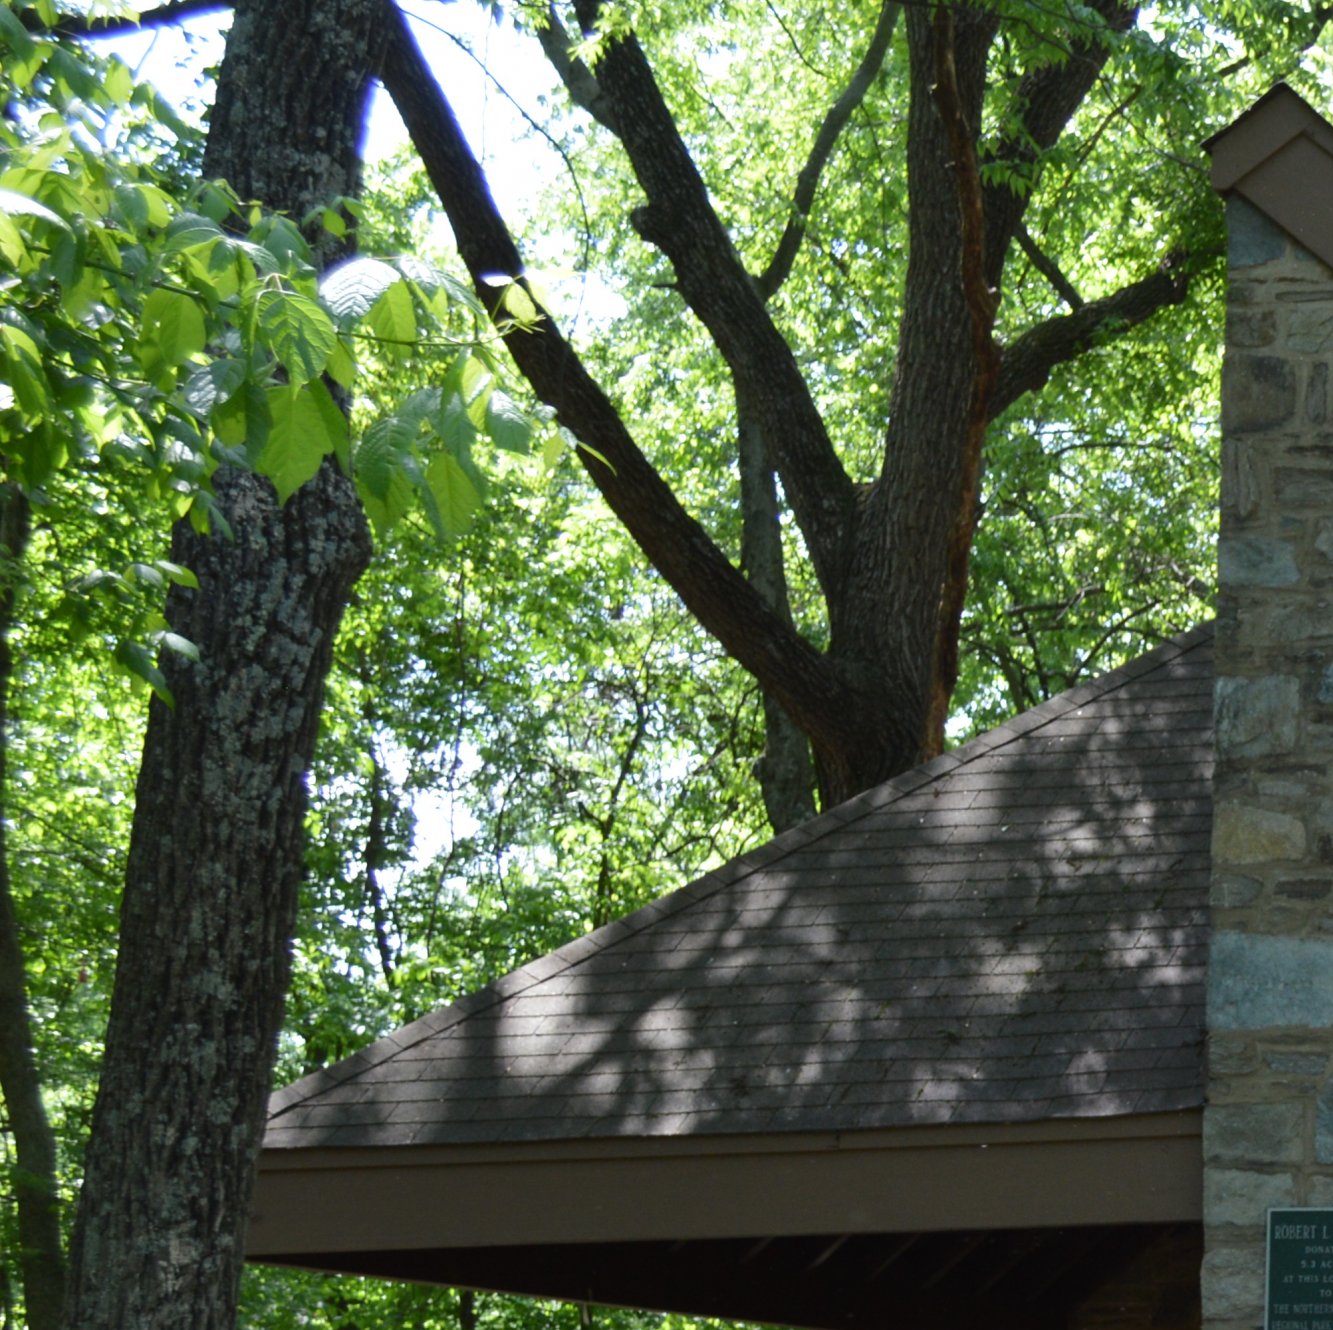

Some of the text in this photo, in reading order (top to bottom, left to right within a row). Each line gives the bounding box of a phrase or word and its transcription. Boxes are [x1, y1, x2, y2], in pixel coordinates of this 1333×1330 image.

[1275, 1224, 1317, 1240] ROBERT
[1283, 1275, 1294, 1283] AT
[1298, 1275, 1319, 1283] THIS
[1319, 1289, 1332, 1297] TO
[1273, 1303, 1289, 1314] THE
